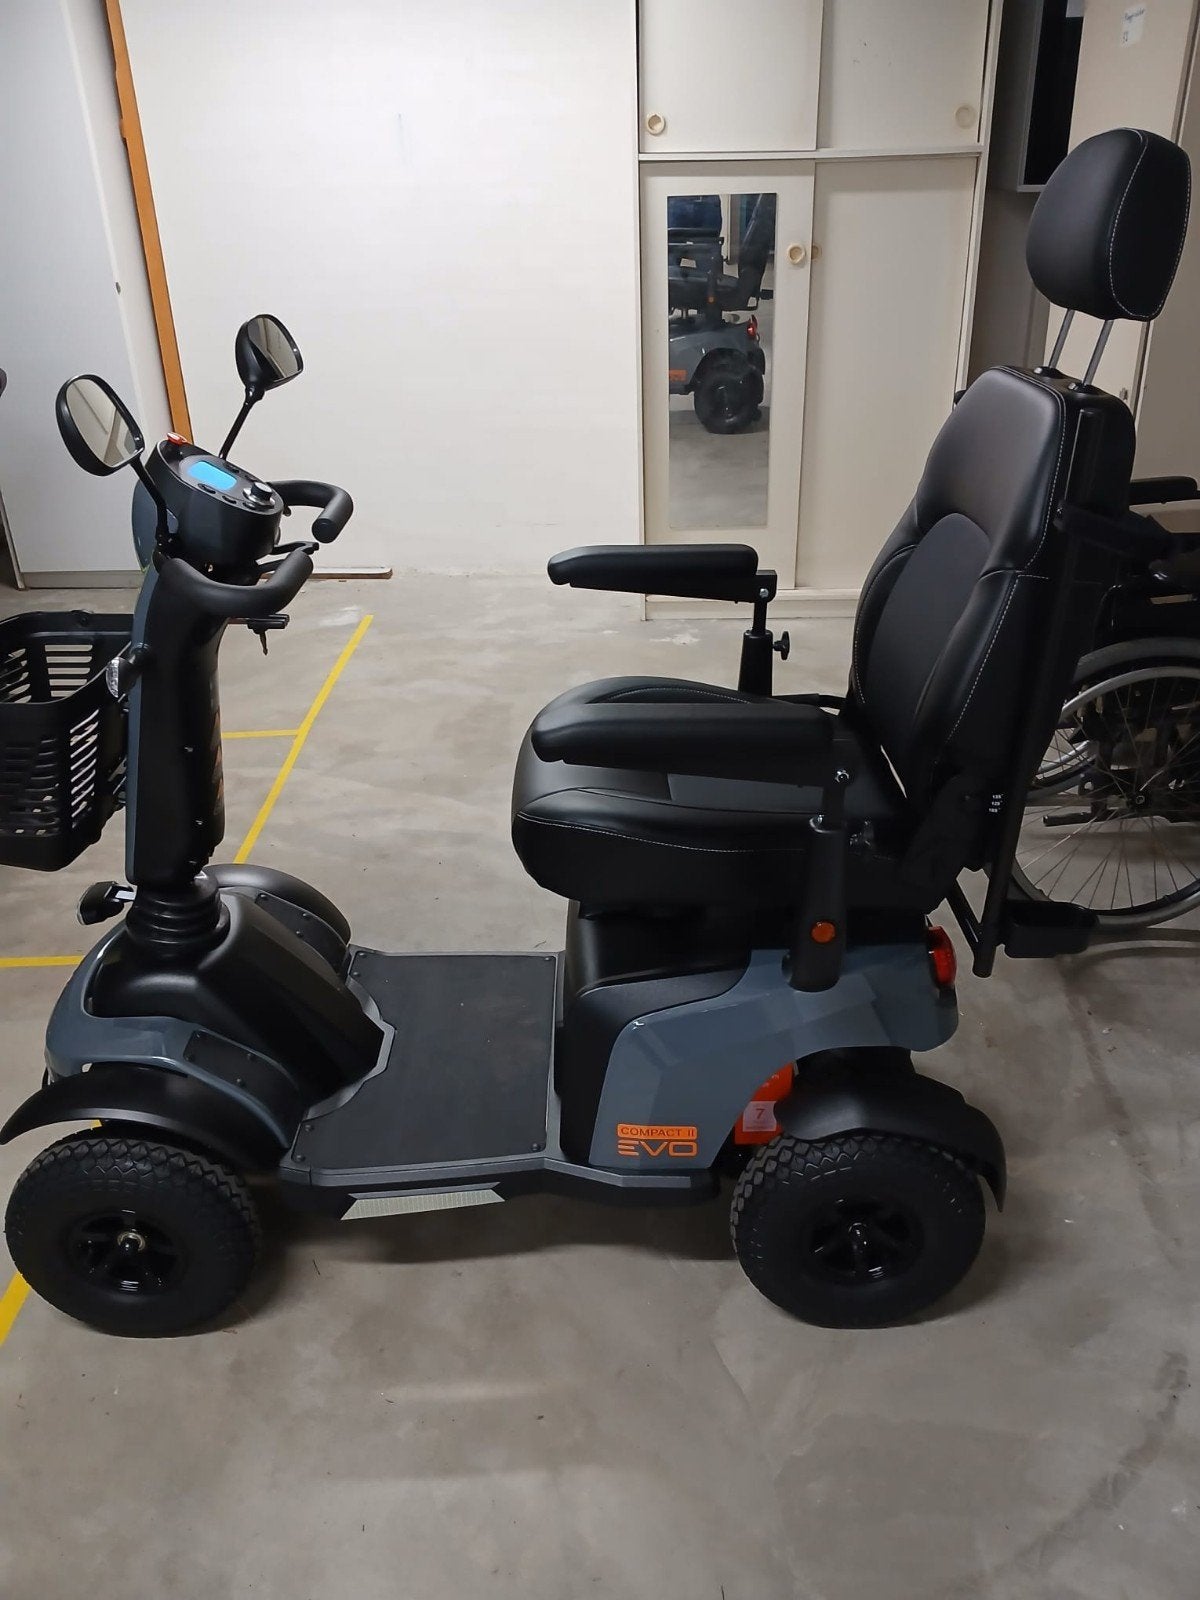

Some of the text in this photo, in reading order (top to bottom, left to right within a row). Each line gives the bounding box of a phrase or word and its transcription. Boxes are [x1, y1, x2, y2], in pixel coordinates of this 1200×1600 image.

[755, 1108, 765, 1119] 7
[620, 1127, 695, 1138] COMPACT II
[617, 1139, 698, 1157] EVO
